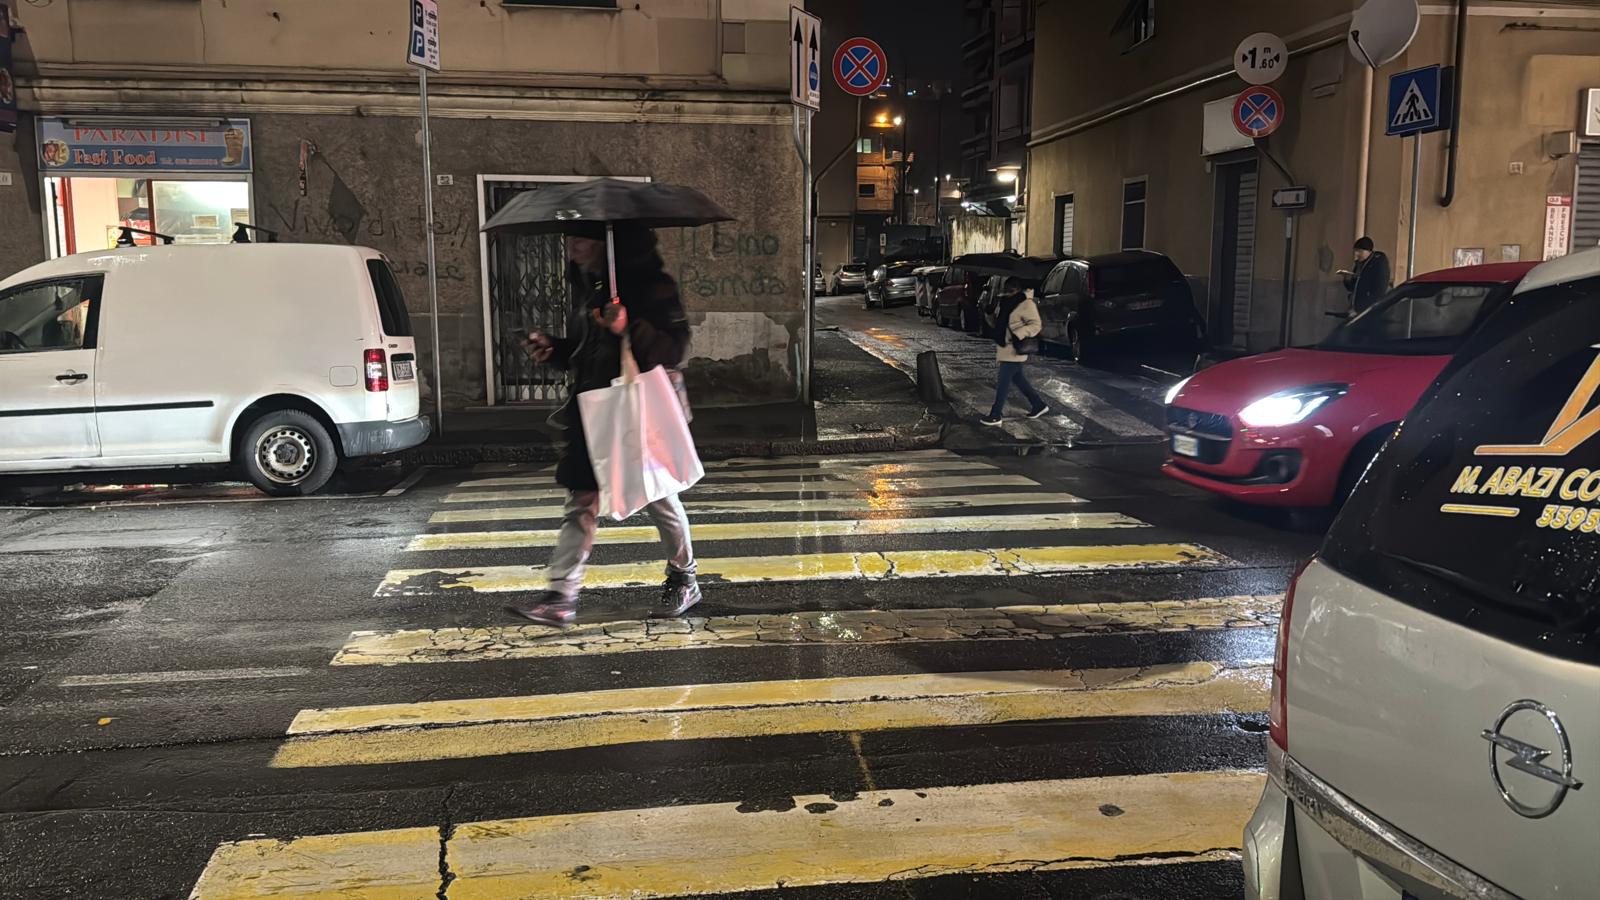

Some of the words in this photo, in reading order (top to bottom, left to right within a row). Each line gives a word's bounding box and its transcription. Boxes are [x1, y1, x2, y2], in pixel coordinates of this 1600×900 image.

[1248, 47, 1257, 69] 1
[72, 148, 109, 166] Fast
[112, 148, 158, 166] Food
[1547, 207, 1556, 248] BEVANDE
[1559, 207, 1567, 248] FRESCHE
[1479, 466, 1565, 498] ABAZI
[1559, 467, 1600, 501] CO
